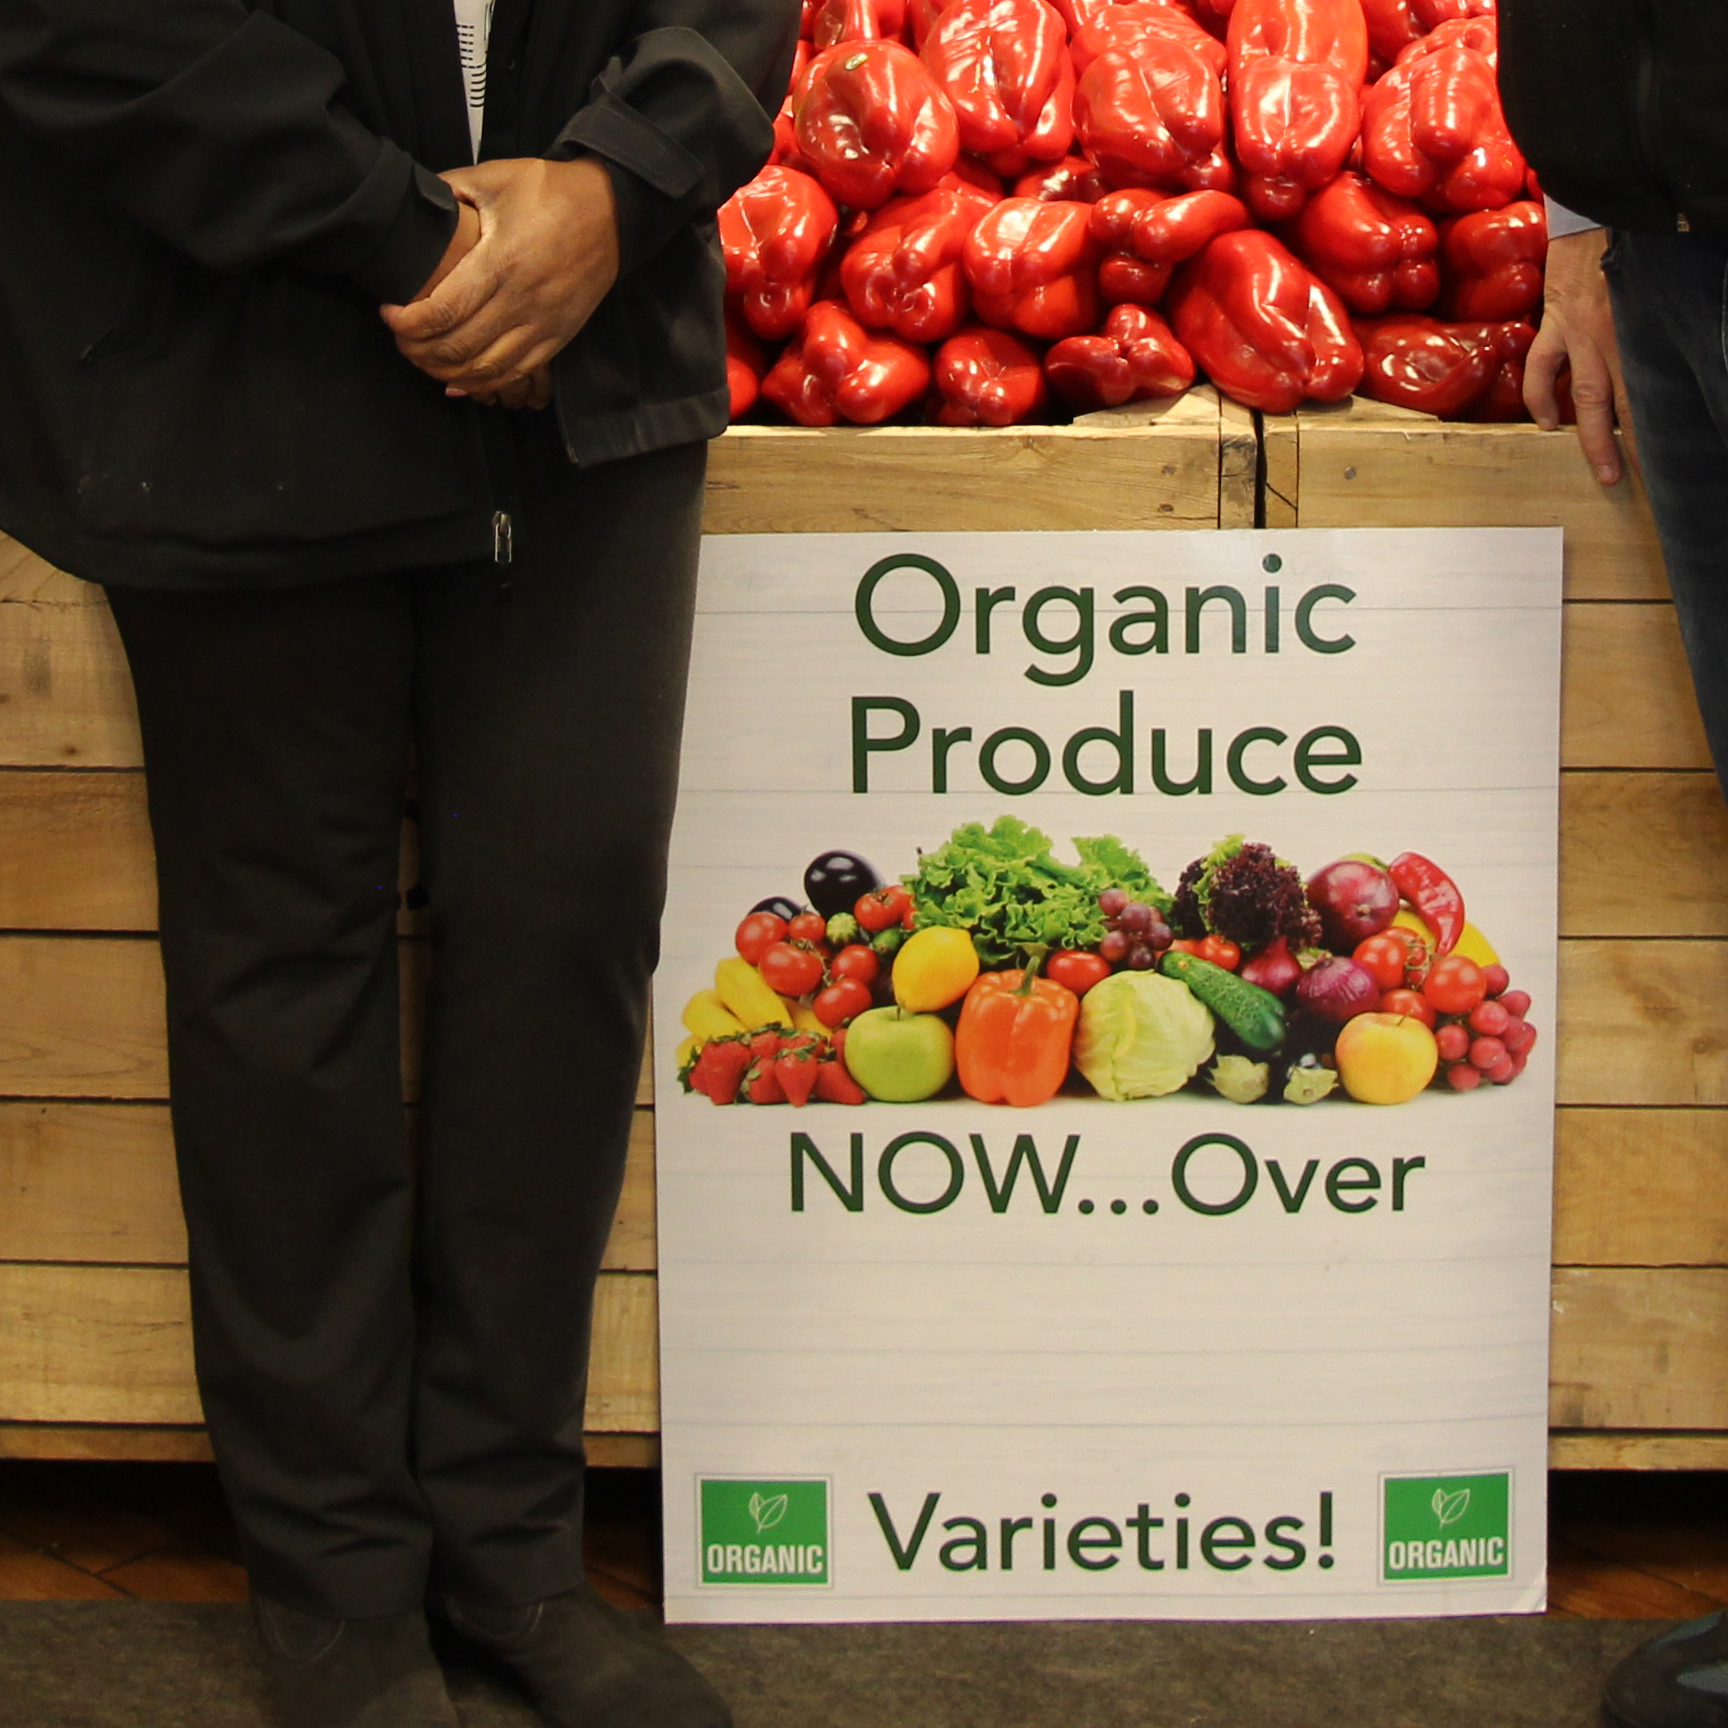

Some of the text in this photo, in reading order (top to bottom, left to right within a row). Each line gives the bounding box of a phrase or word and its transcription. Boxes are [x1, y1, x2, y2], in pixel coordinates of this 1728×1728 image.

[854, 553, 1356, 686] Organic
[851, 690, 1363, 796] Produce
[789, 1131, 1426, 1216] NOW...Over
[707, 1544, 823, 1574] ORGANIC
[868, 1491, 1335, 1572] Varieties!
[1389, 1538, 1503, 1570] ORGANIC
